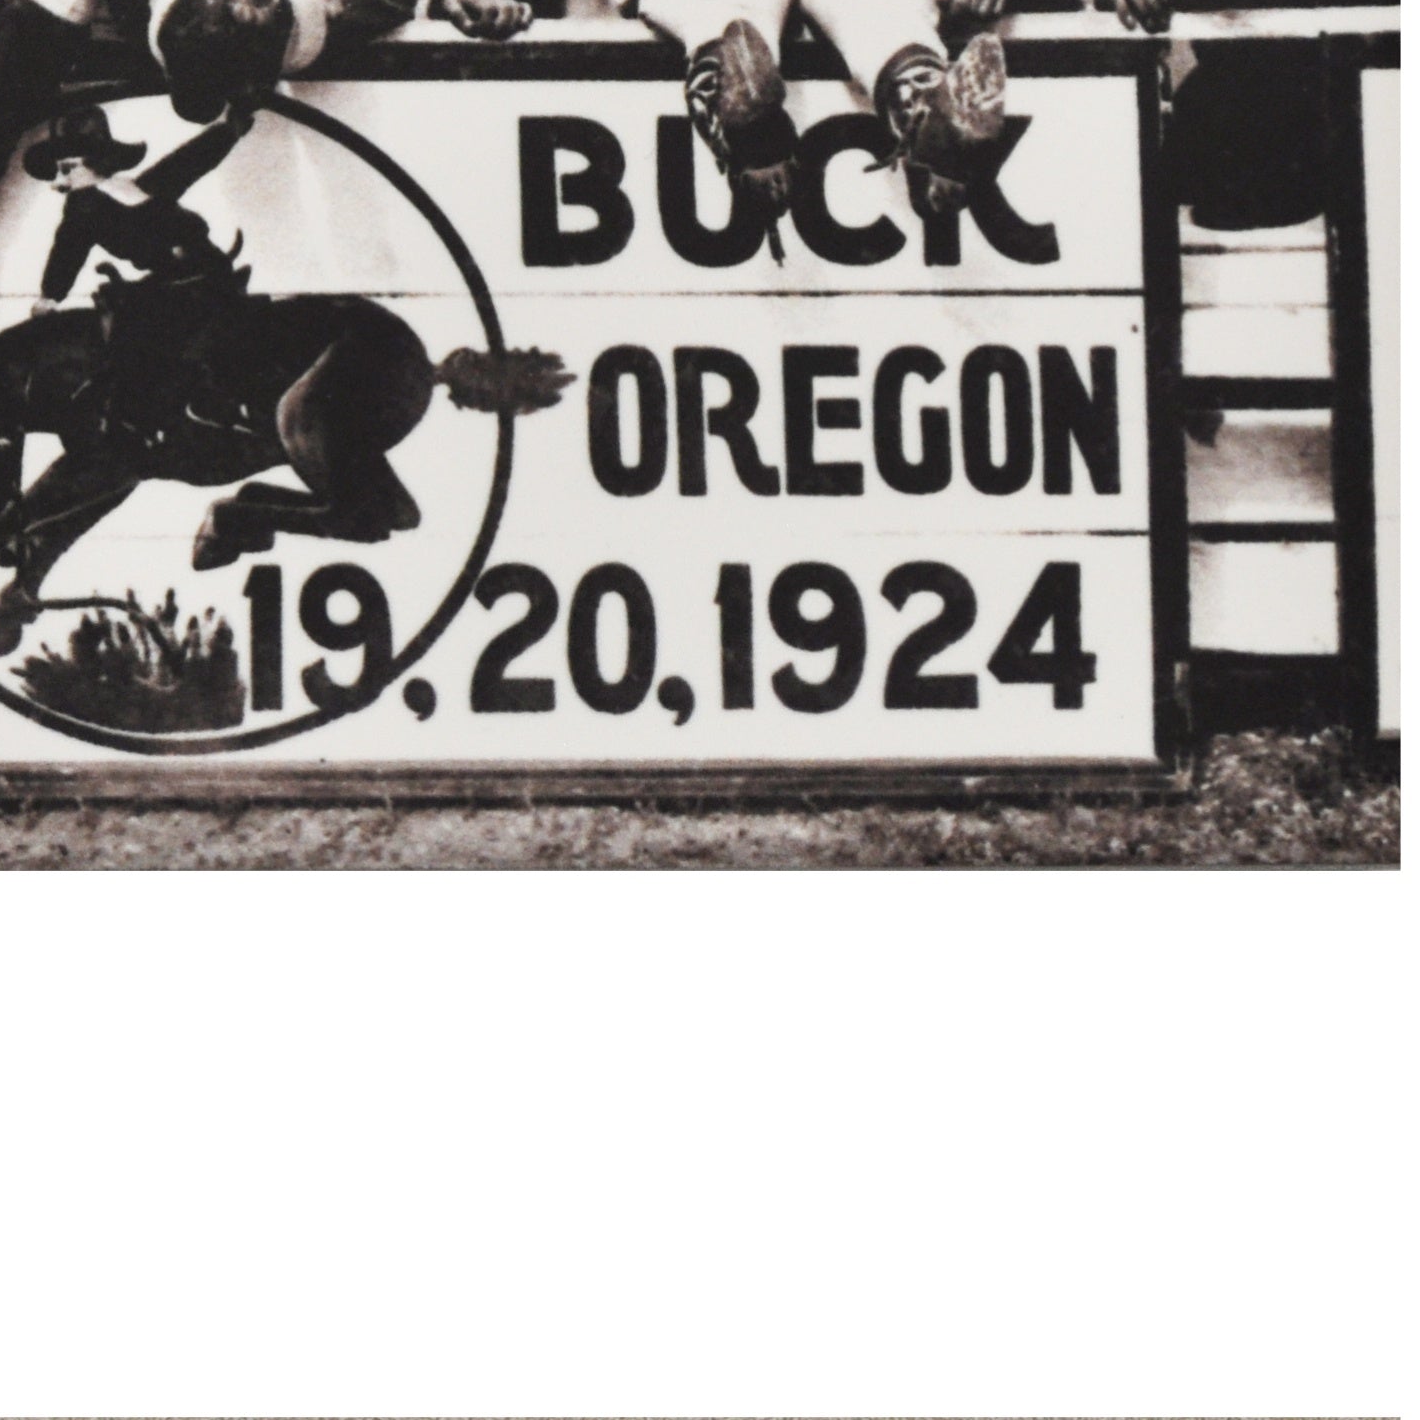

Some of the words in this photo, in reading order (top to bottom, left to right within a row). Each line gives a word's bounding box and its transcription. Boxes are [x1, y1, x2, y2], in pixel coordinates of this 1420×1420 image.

[518, 112, 1060, 268] BUCK
[586, 344, 1121, 497] OREGON
[241, 562, 437, 722] 19,
[469, 561, 696, 726] 20,
[714, 561, 1098, 715] 1924
